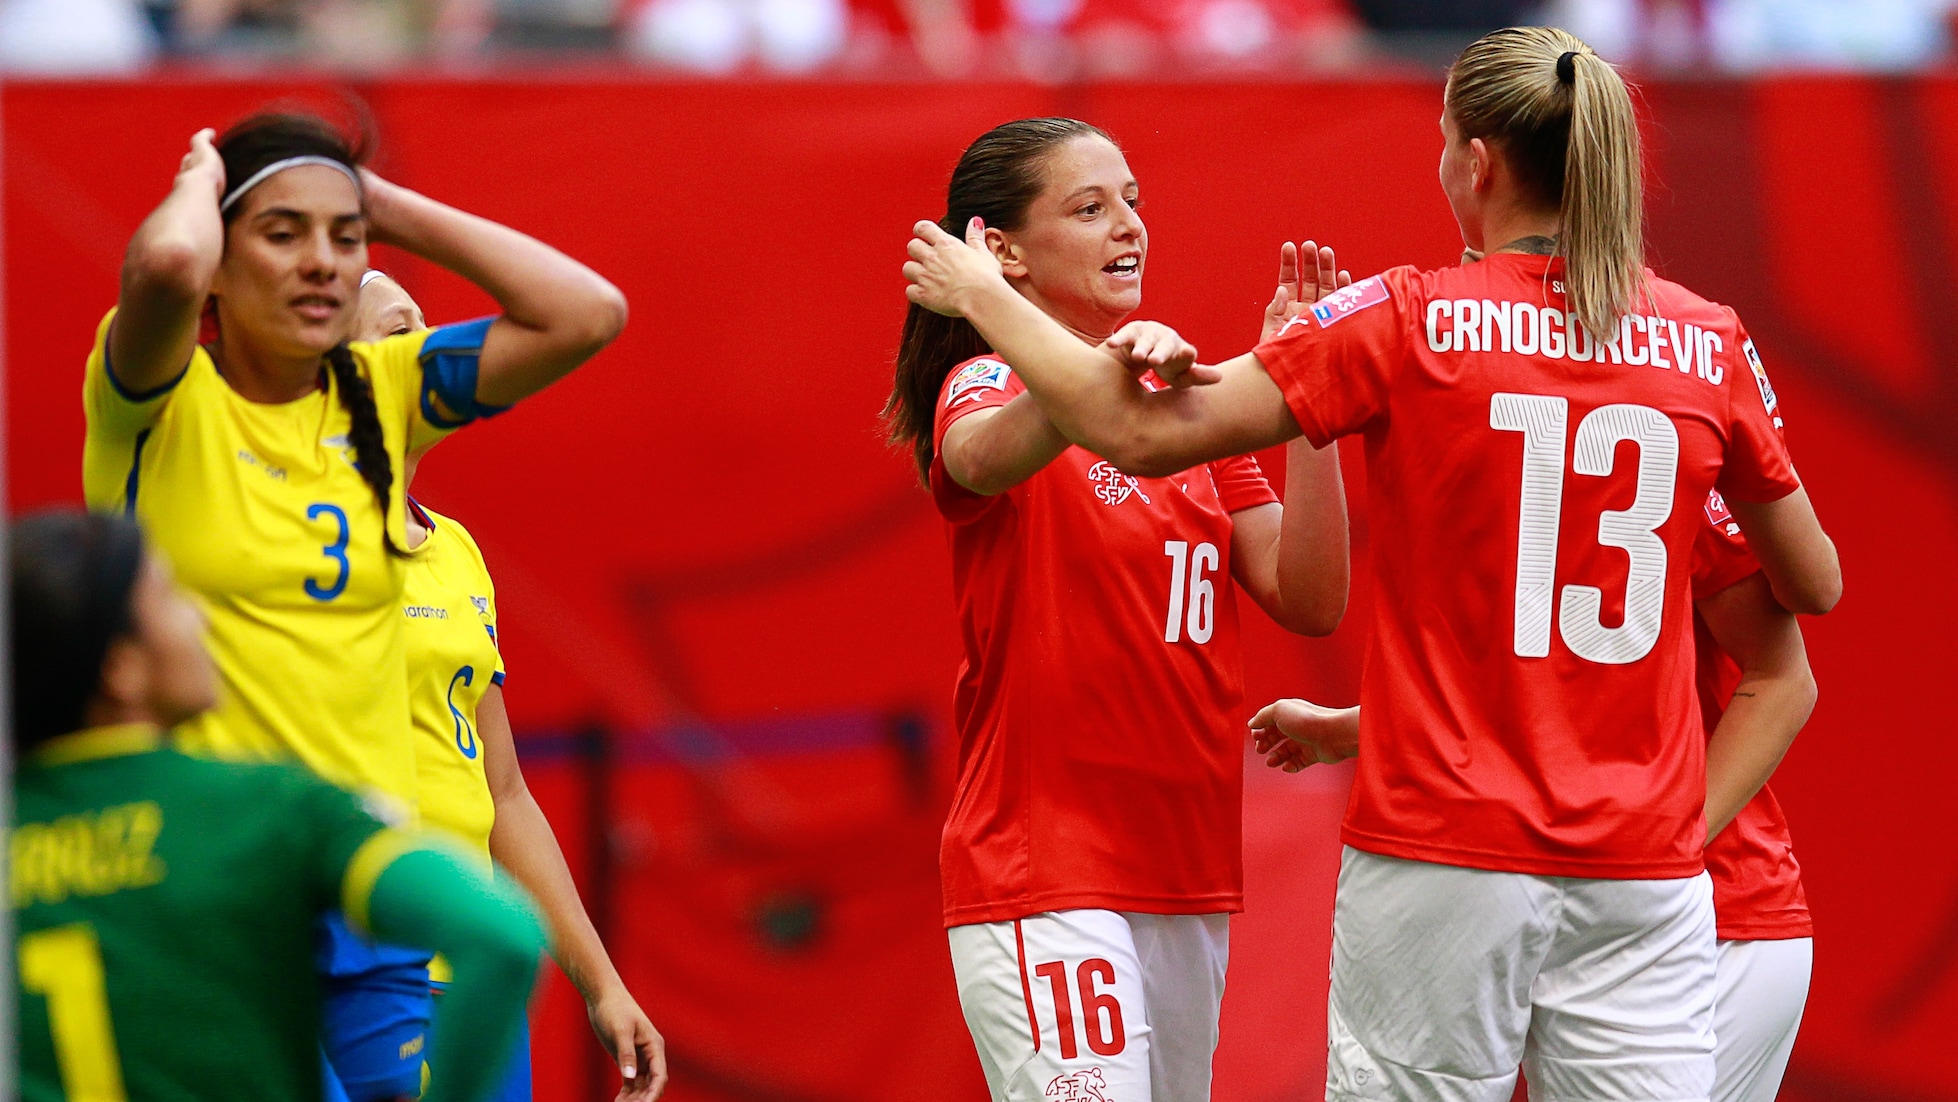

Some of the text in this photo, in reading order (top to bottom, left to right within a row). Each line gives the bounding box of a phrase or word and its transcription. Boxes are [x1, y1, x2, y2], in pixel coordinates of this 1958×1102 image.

[304, 503, 349, 602] 3
[1489, 392, 1680, 665] 13
[1164, 540, 1219, 645] 16
[447, 665, 477, 760] 6
[19, 921, 129, 1102] 1
[1035, 957, 1126, 1060] 16
